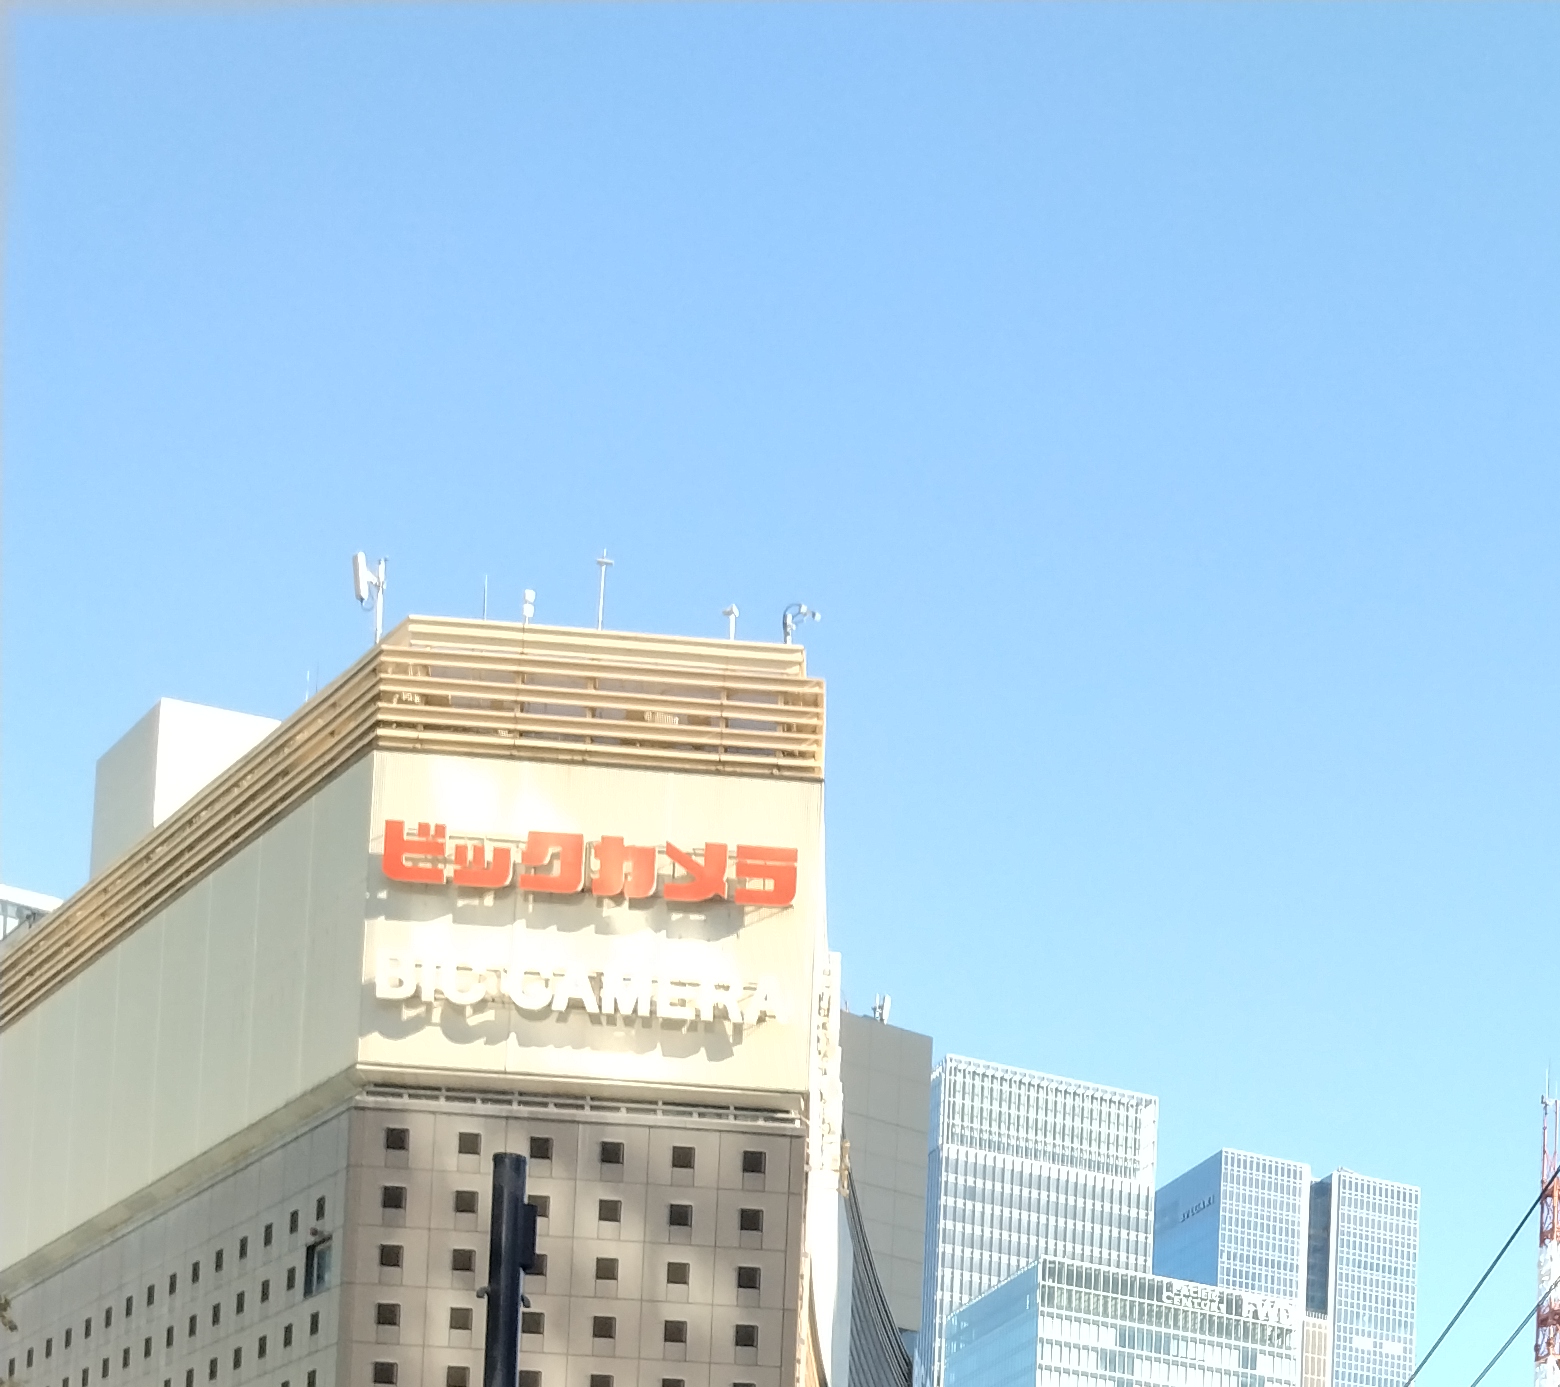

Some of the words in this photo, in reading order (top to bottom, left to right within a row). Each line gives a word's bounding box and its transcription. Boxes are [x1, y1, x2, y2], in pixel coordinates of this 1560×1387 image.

[381, 818, 798, 906] ビックカメラ
[374, 957, 490, 1006] BIC
[508, 964, 790, 1025] CAMERA
